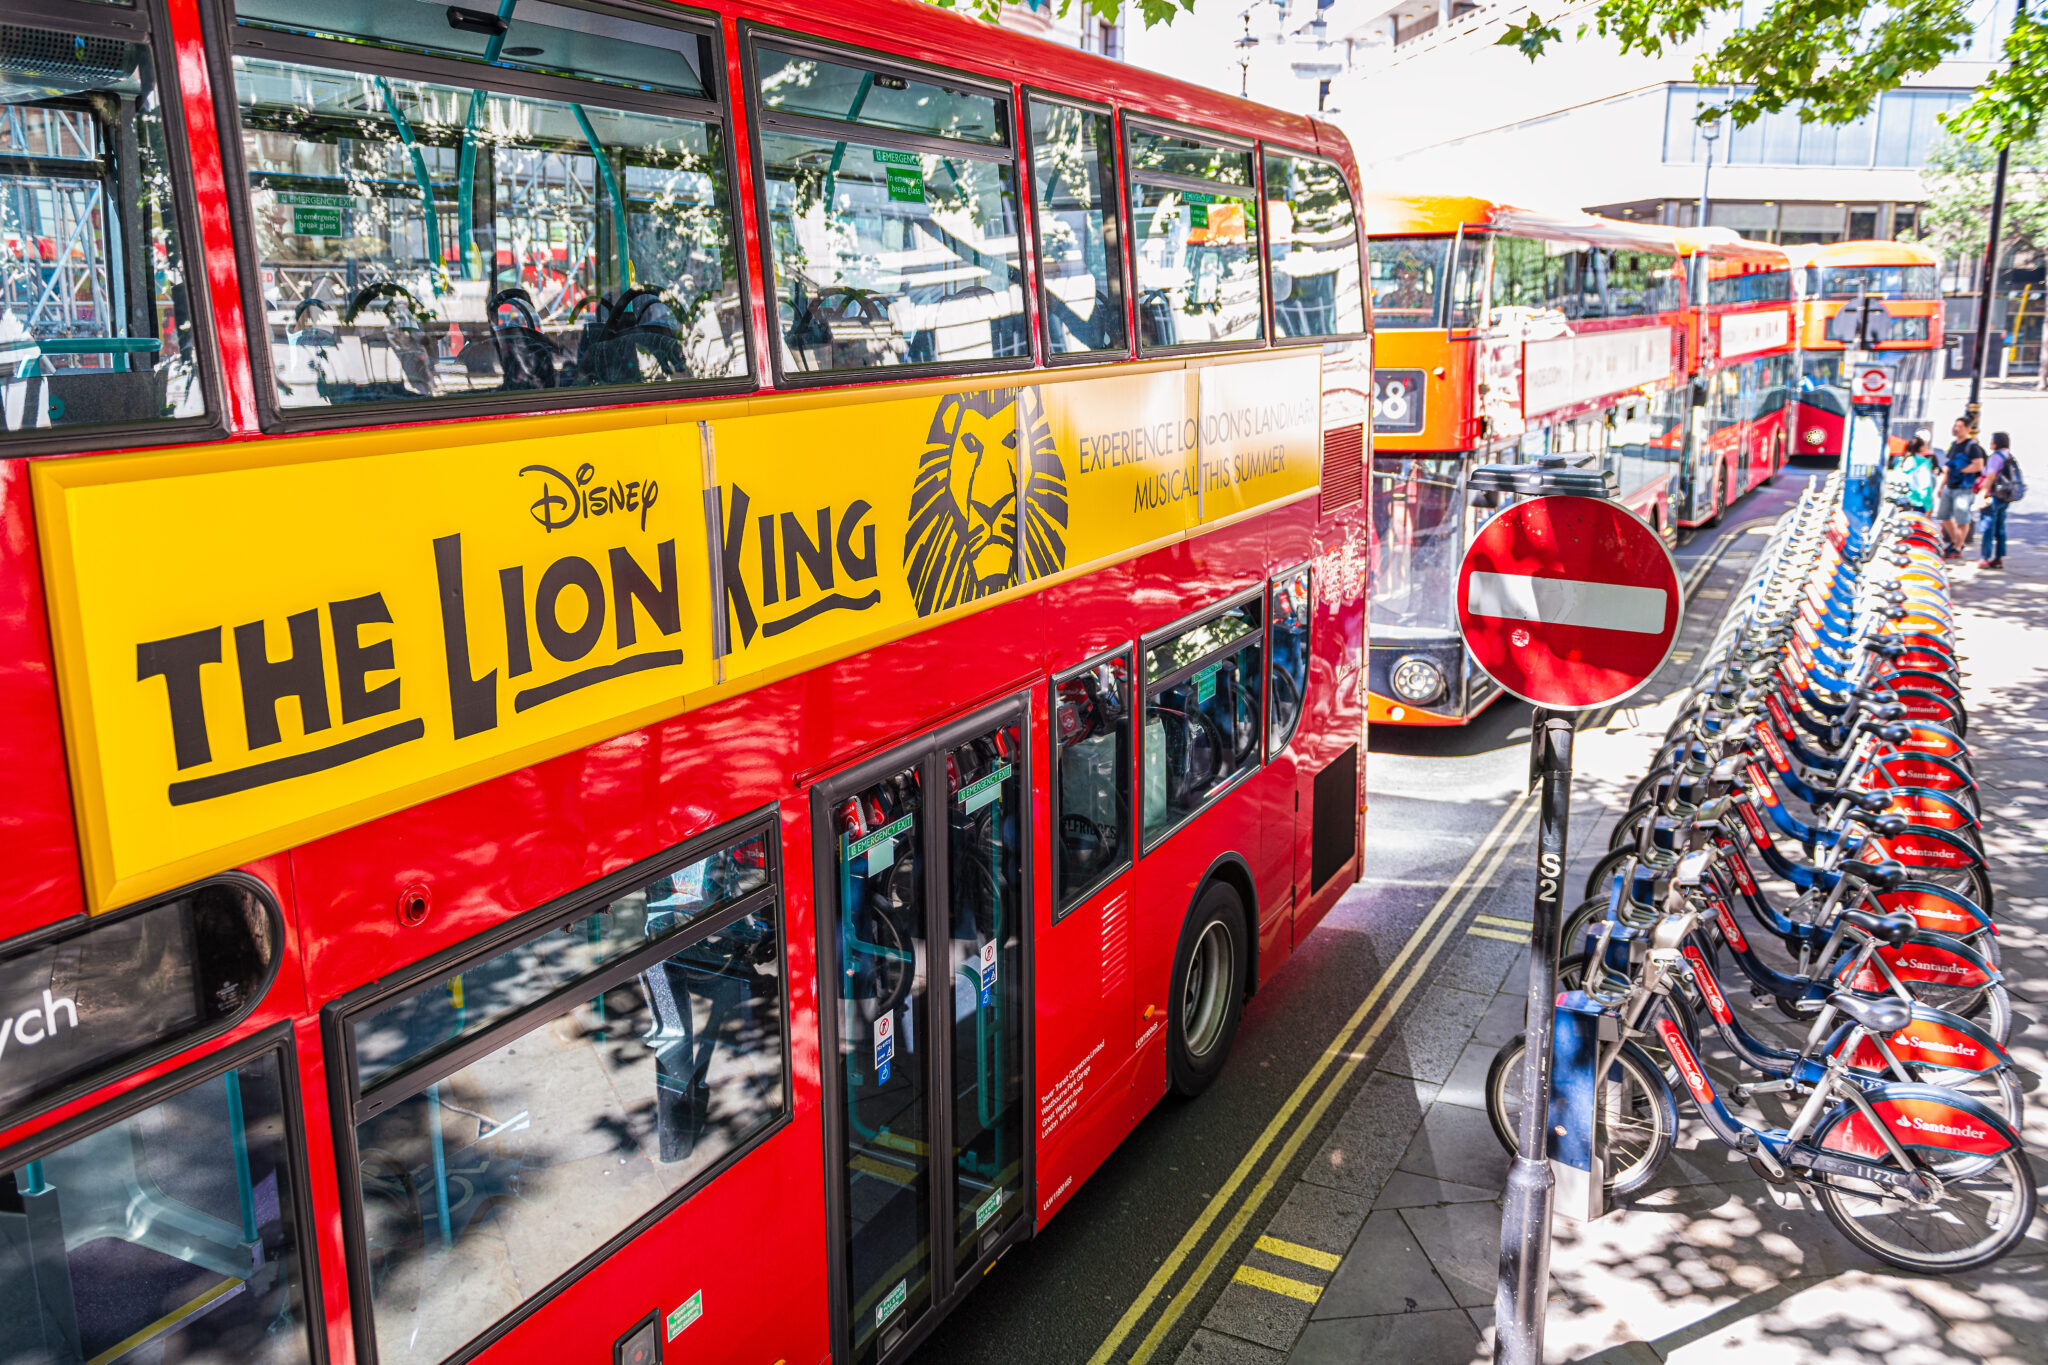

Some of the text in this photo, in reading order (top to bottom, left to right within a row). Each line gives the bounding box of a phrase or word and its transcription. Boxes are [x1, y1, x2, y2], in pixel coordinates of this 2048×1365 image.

[289, 195, 337, 207] EMERGENCY
[299, 221, 337, 231] break glass
[303, 213, 339, 223] emergency
[1079, 420, 1173, 474] EXPERIENCE
[1178, 408, 1252, 451] LONDON'S
[1134, 444, 1286, 514] MUSICAL THIS SUMMER
[518, 462, 659, 533] Disney
[136, 482, 878, 771] THE LION KING
[1907, 770, 1951, 781] Santander
[857, 816, 911, 852] EMERGENCY EXIT
[1906, 846, 1956, 860] Santander
[1906, 904, 1963, 922] Santander
[1908, 958, 1969, 977] Santander
[1909, 1034, 1978, 1058] Santander
[1040, 1038, 1105, 1105] Tower Transit Operations Limited
[1040, 1088, 1068, 1116] Westbourne
[1066, 1078, 1077, 1092] Park
[1055, 1094, 1074, 1115] Western
[1041, 1119, 1059, 1139] London
[1912, 1116, 1987, 1141] Santander
